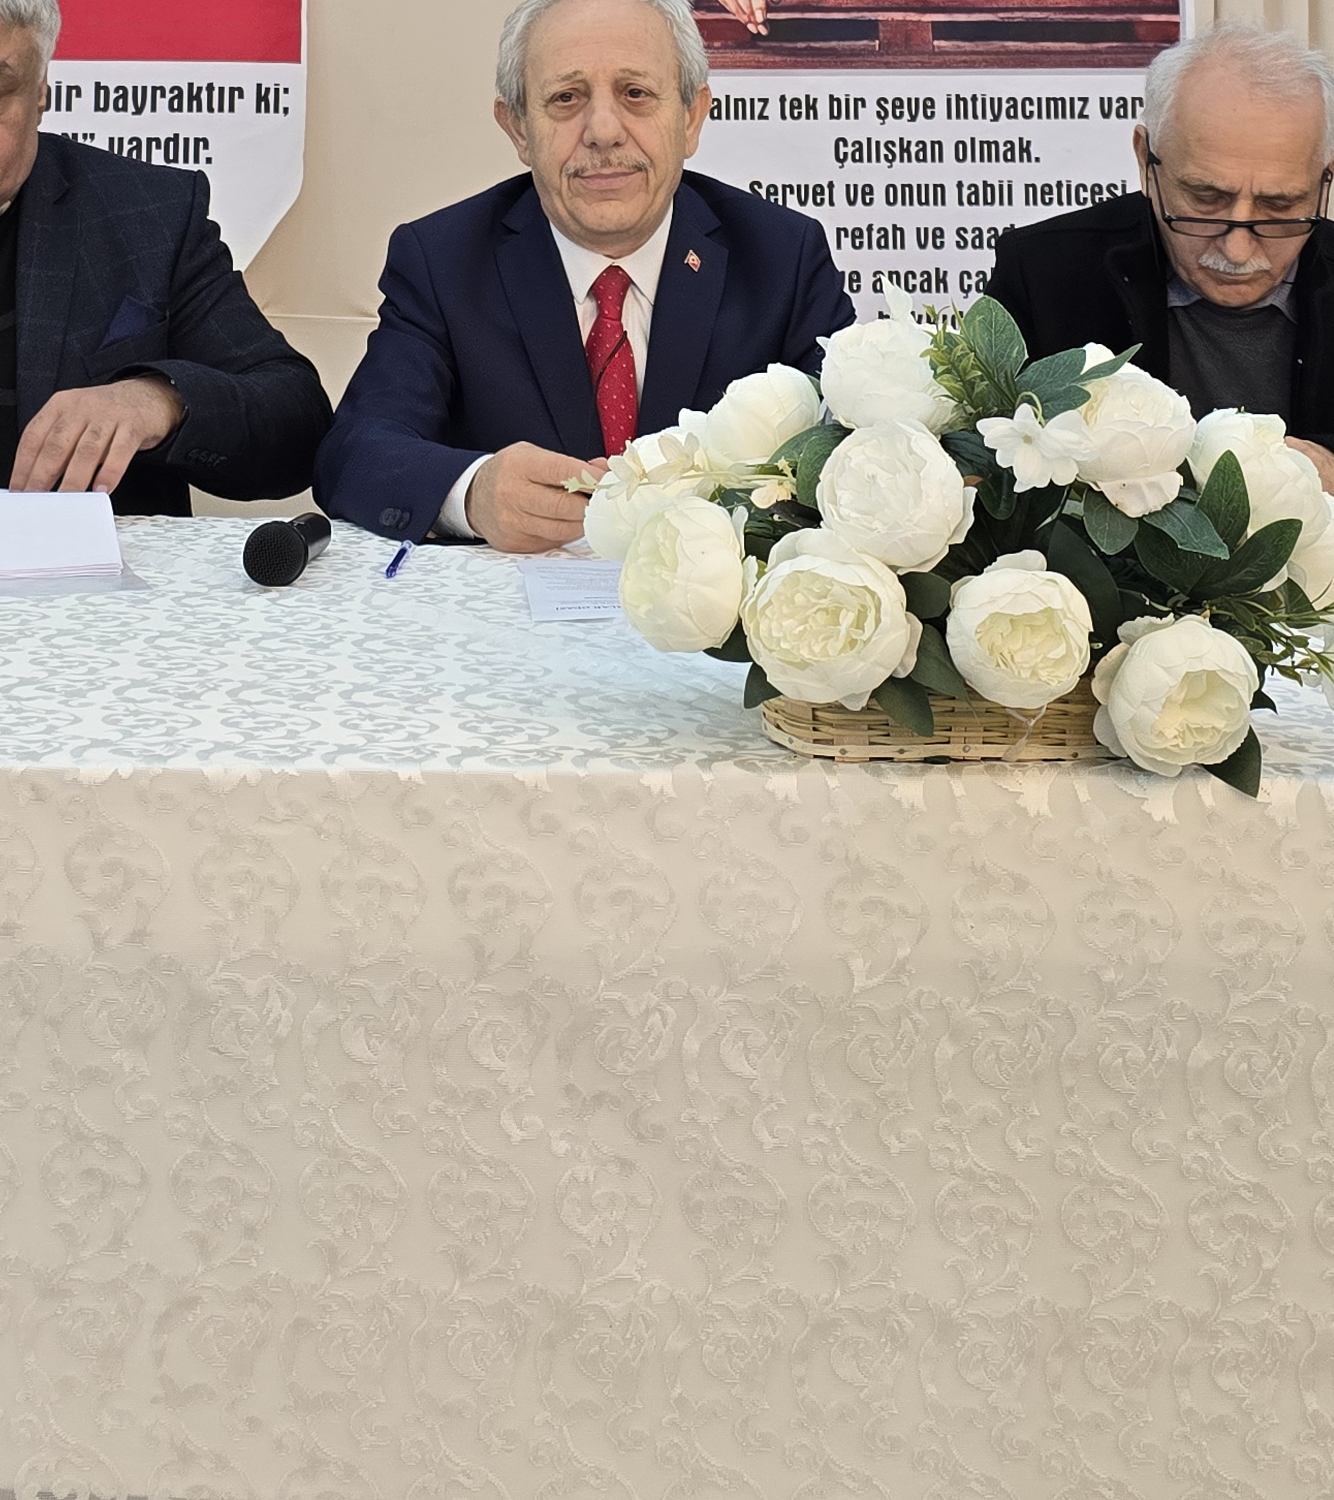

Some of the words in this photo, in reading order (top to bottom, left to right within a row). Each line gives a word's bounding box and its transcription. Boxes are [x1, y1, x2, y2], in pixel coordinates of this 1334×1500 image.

[93, 81, 244, 116] bayraktır
[255, 83, 289, 117] ki;
[709, 94, 770, 121] alnız
[779, 94, 819, 121] tek
[828, 94, 867, 121] bir
[875, 97, 936, 125] şeye
[946, 94, 1090, 122] ihtiyacımız
[834, 137, 944, 169] Çalışkan
[954, 137, 1041, 163] olmak.
[749, 181, 835, 207] Servet
[845, 184, 874, 206] ve
[884, 184, 946, 206] onun
[956, 180, 1014, 206] tabii
[836, 224, 906, 250] refah
[916, 227, 945, 250] ve
